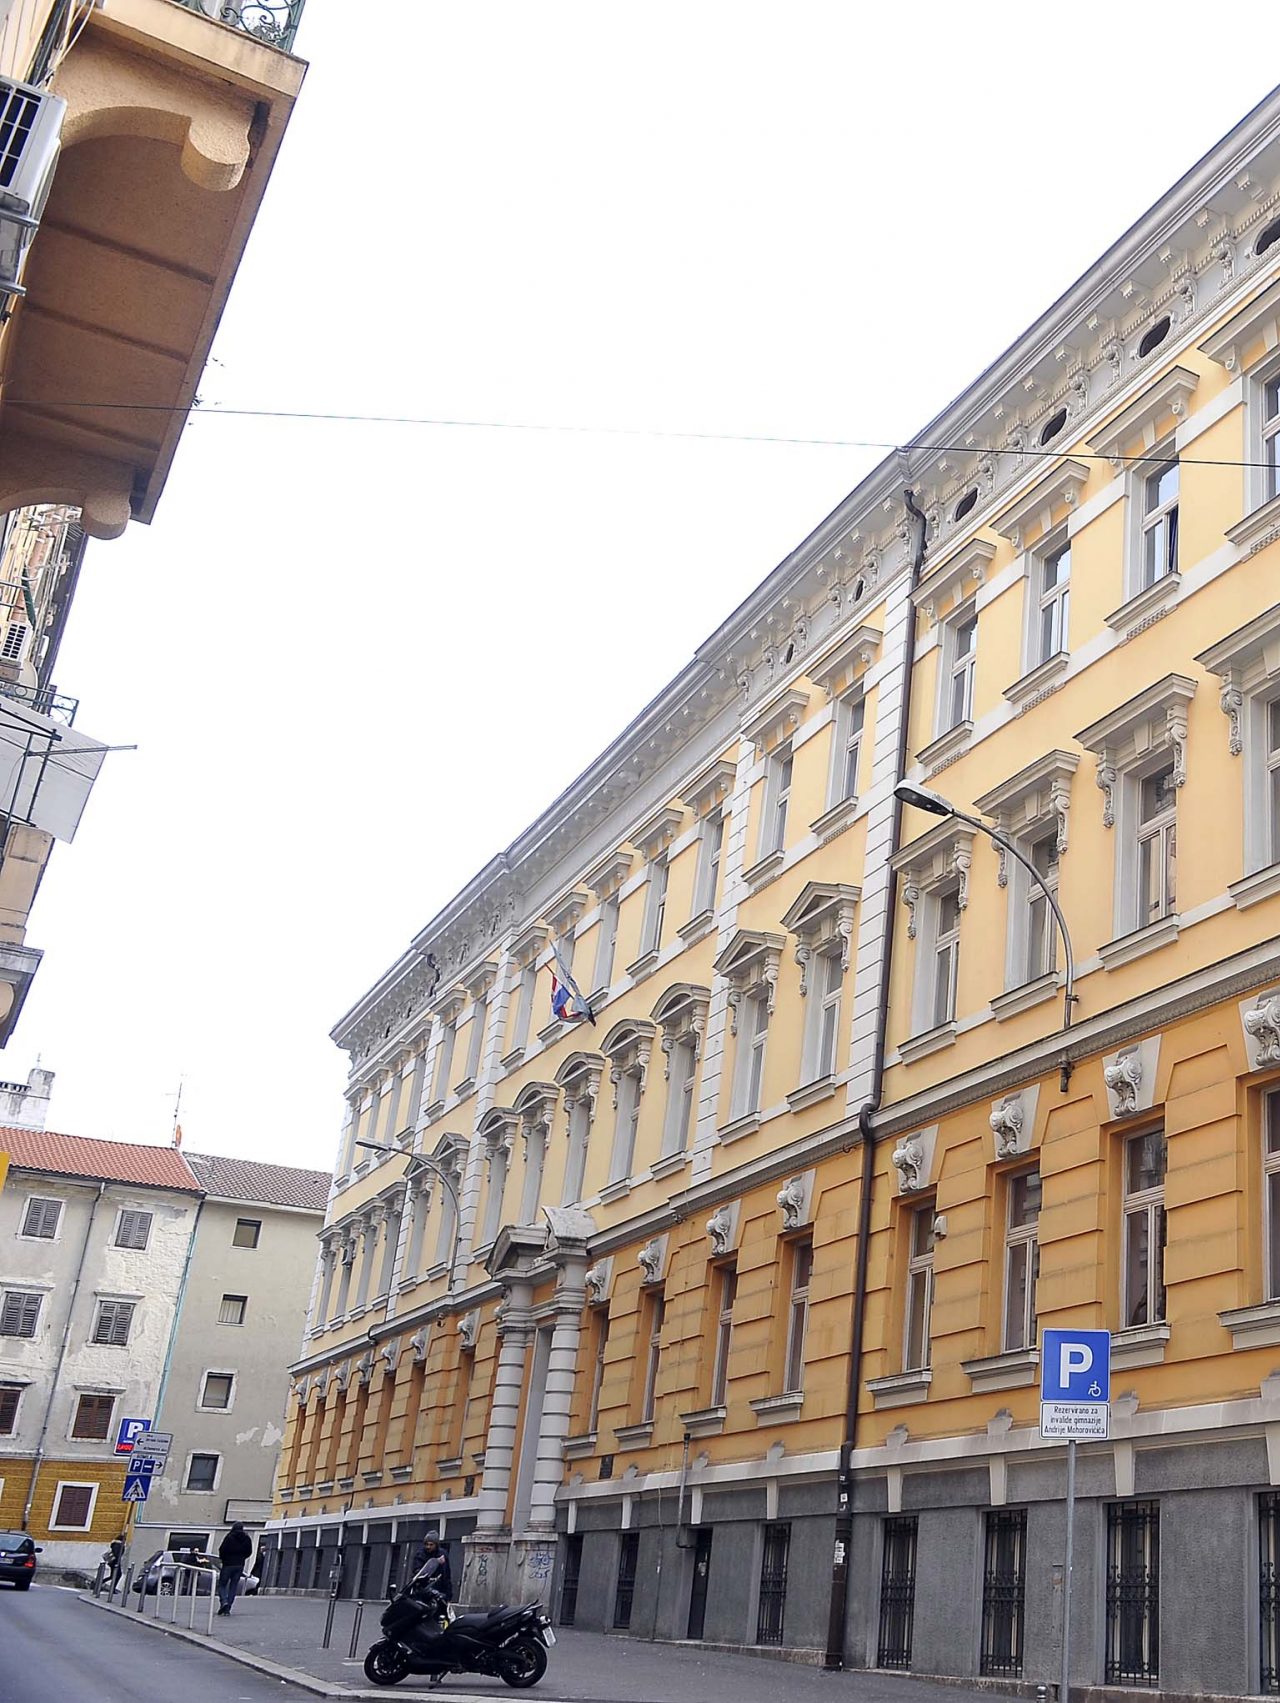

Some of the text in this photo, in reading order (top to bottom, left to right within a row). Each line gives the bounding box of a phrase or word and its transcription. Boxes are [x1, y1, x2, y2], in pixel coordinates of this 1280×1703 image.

[1059, 1343, 1093, 1388] P
[1054, 1406, 1089, 1414] Rezervirano
[1050, 1415, 1101, 1426] invalide gimnazije
[127, 1422, 143, 1438] P
[1044, 1425, 1066, 1435] Andrije
[133, 1461, 140, 1470] P
